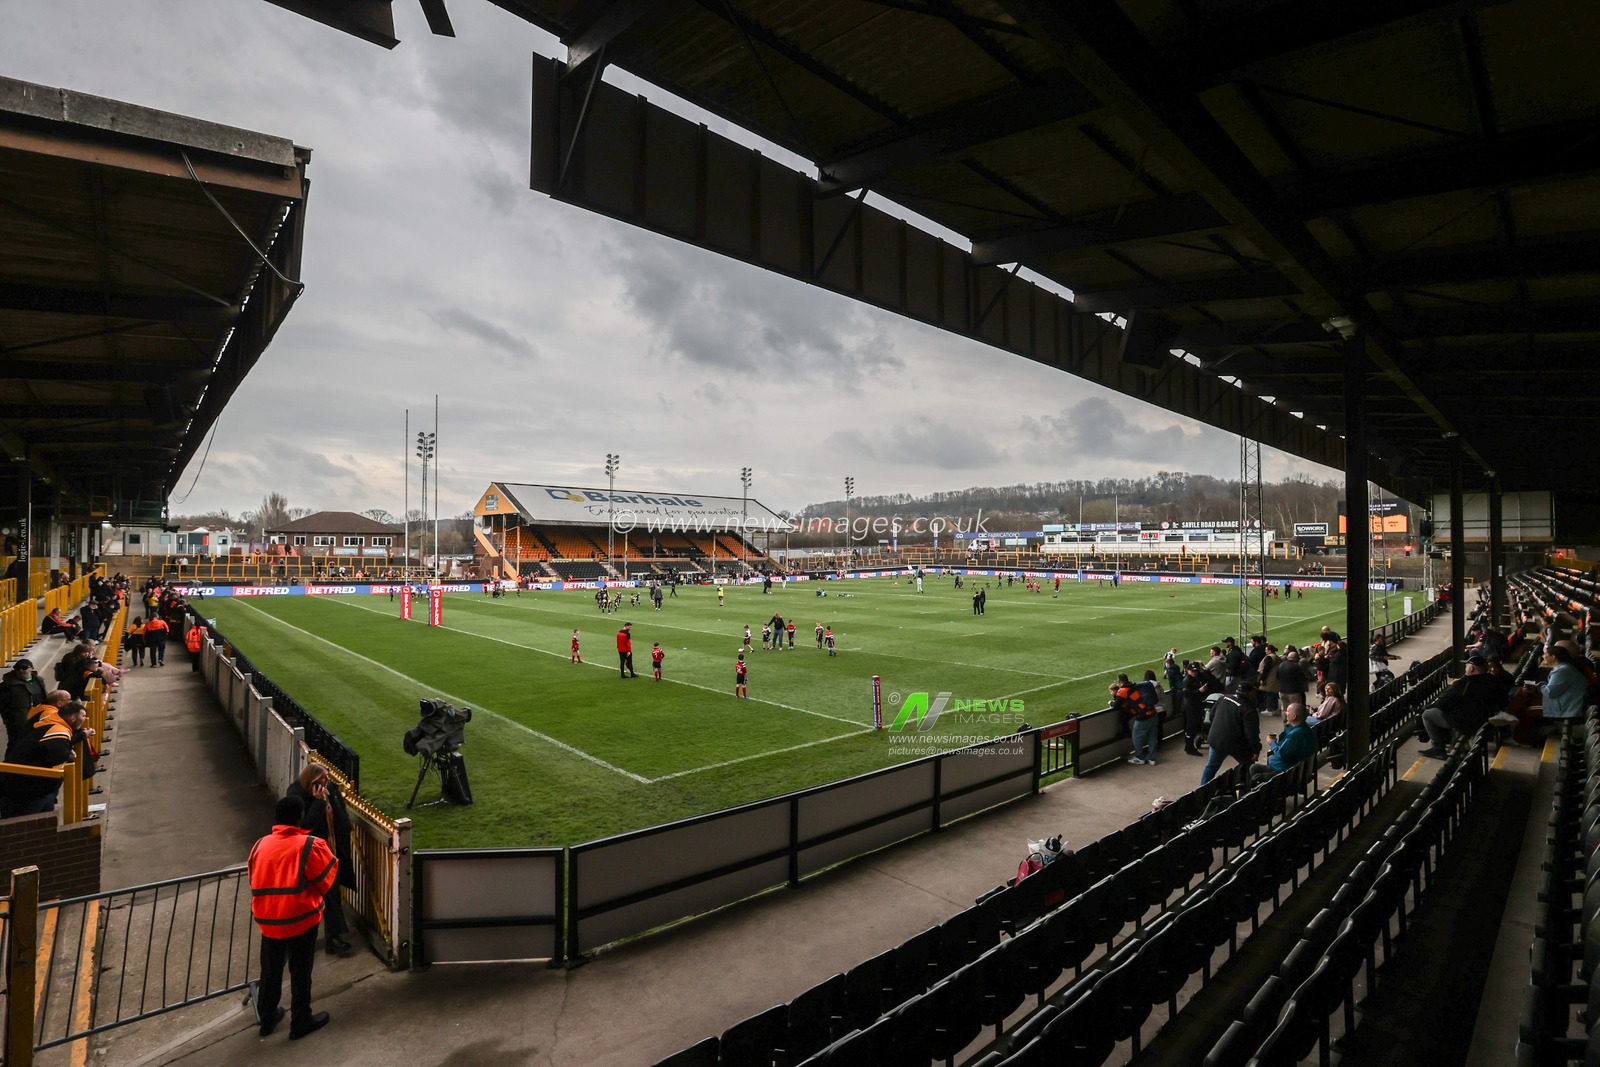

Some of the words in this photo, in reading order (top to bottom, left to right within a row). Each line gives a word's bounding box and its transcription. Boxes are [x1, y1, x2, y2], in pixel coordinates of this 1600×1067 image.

[582, 491, 703, 507] Barhale
[665, 507, 683, 518] for
[236, 587, 289, 595] BETFRED
